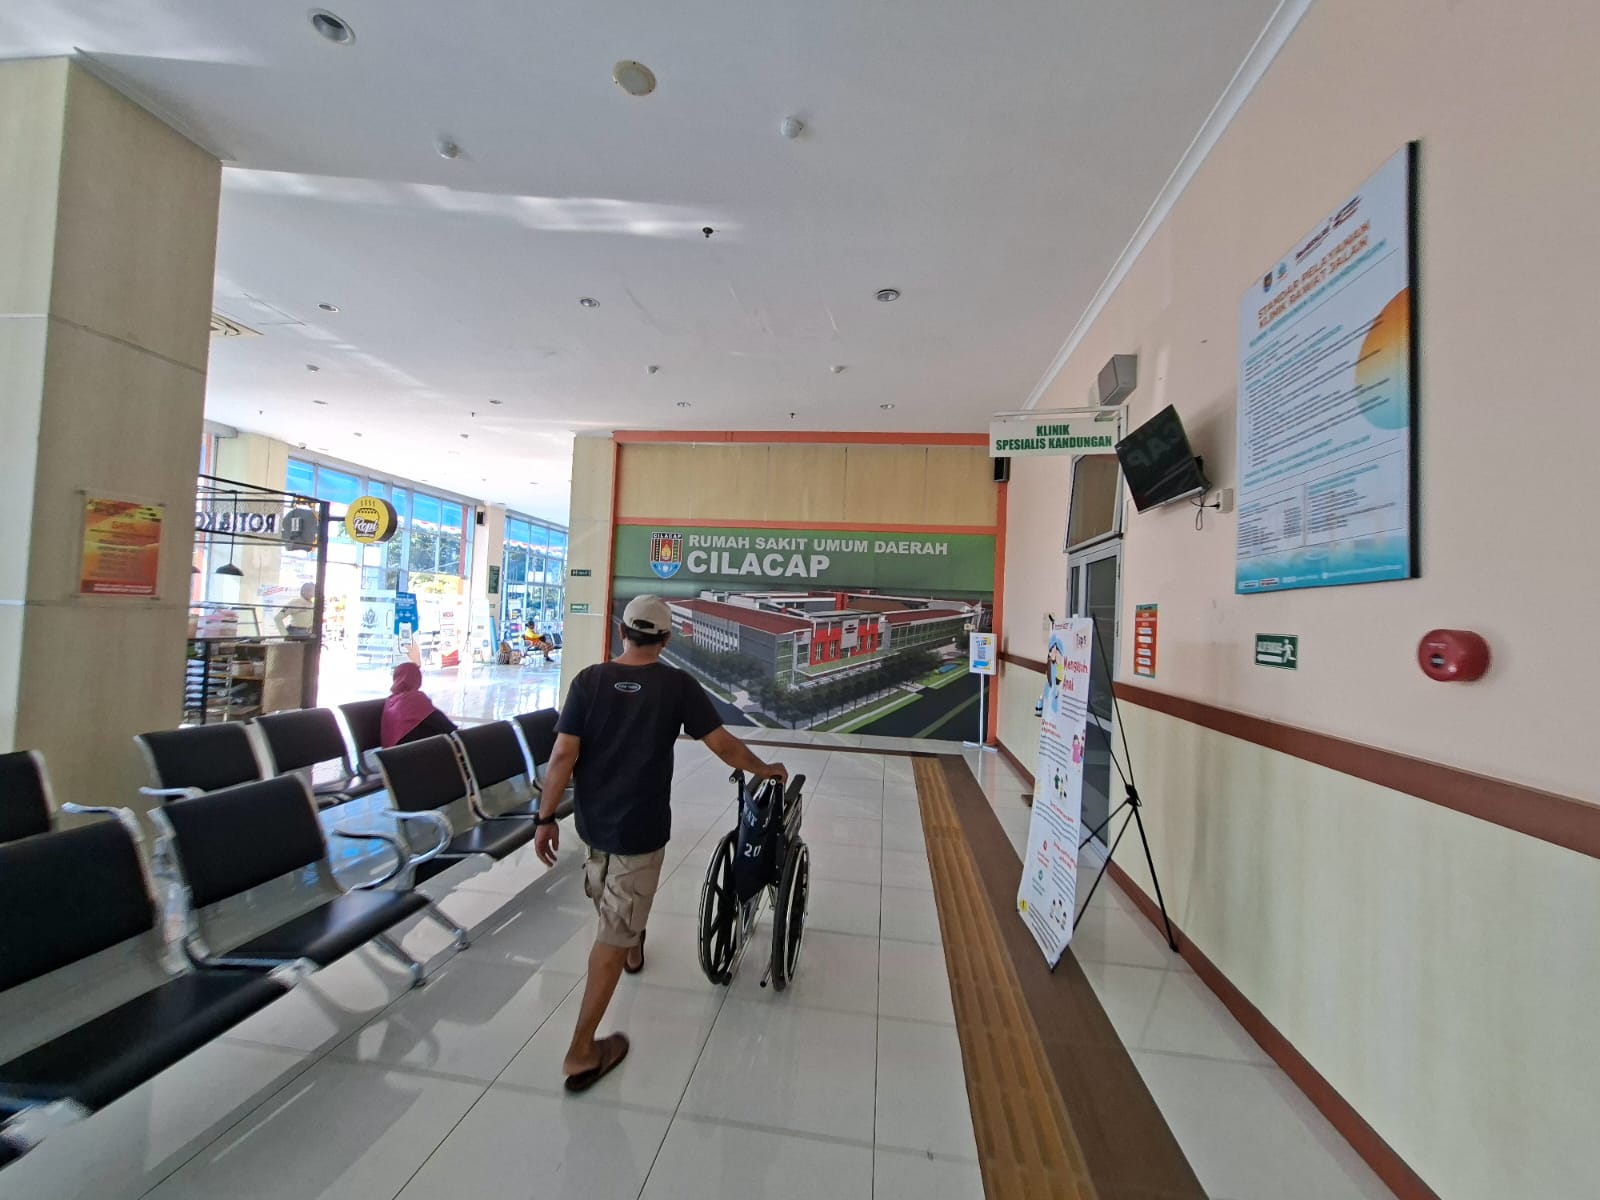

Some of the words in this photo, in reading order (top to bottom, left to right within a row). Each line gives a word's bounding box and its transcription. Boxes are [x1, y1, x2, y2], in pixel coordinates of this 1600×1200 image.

[1036, 424, 1070, 436] KLINIK
[996, 438, 1046, 450] SPESIALIS
[1048, 435, 1112, 449] KANDUNGAN
[689, 535, 749, 549] RUMAH
[755, 537, 808, 550] SAKIT
[813, 539, 868, 552] UMUM
[874, 541, 948, 555] DAERAH
[687, 550, 830, 578] CILACAP
[744, 842, 762, 857] 20
